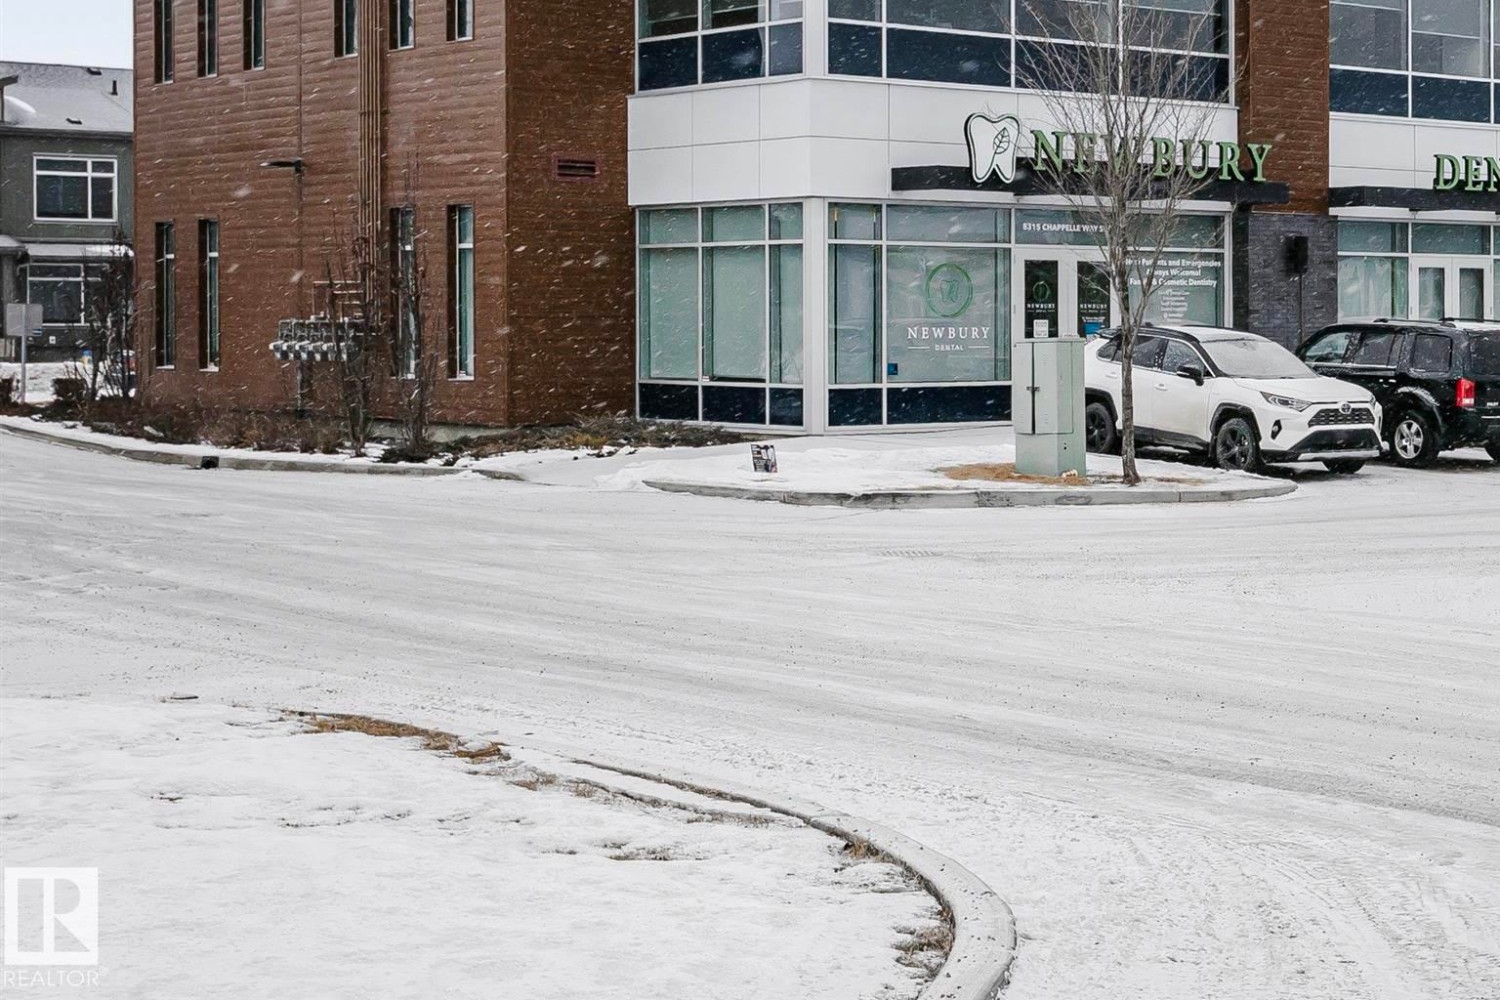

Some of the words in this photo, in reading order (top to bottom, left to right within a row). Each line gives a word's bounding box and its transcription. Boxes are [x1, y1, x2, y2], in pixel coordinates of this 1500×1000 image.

[1022, 222, 1041, 231] 8315
[1042, 223, 1081, 232] CHAPPELLE
[1142, 258, 1167, 267] Patnts
[1146, 268, 1169, 278] Aways
[1188, 279, 1218, 288] Dentistry
[907, 326, 991, 340] NEWBURY
[934, 343, 964, 351] DENTAL
